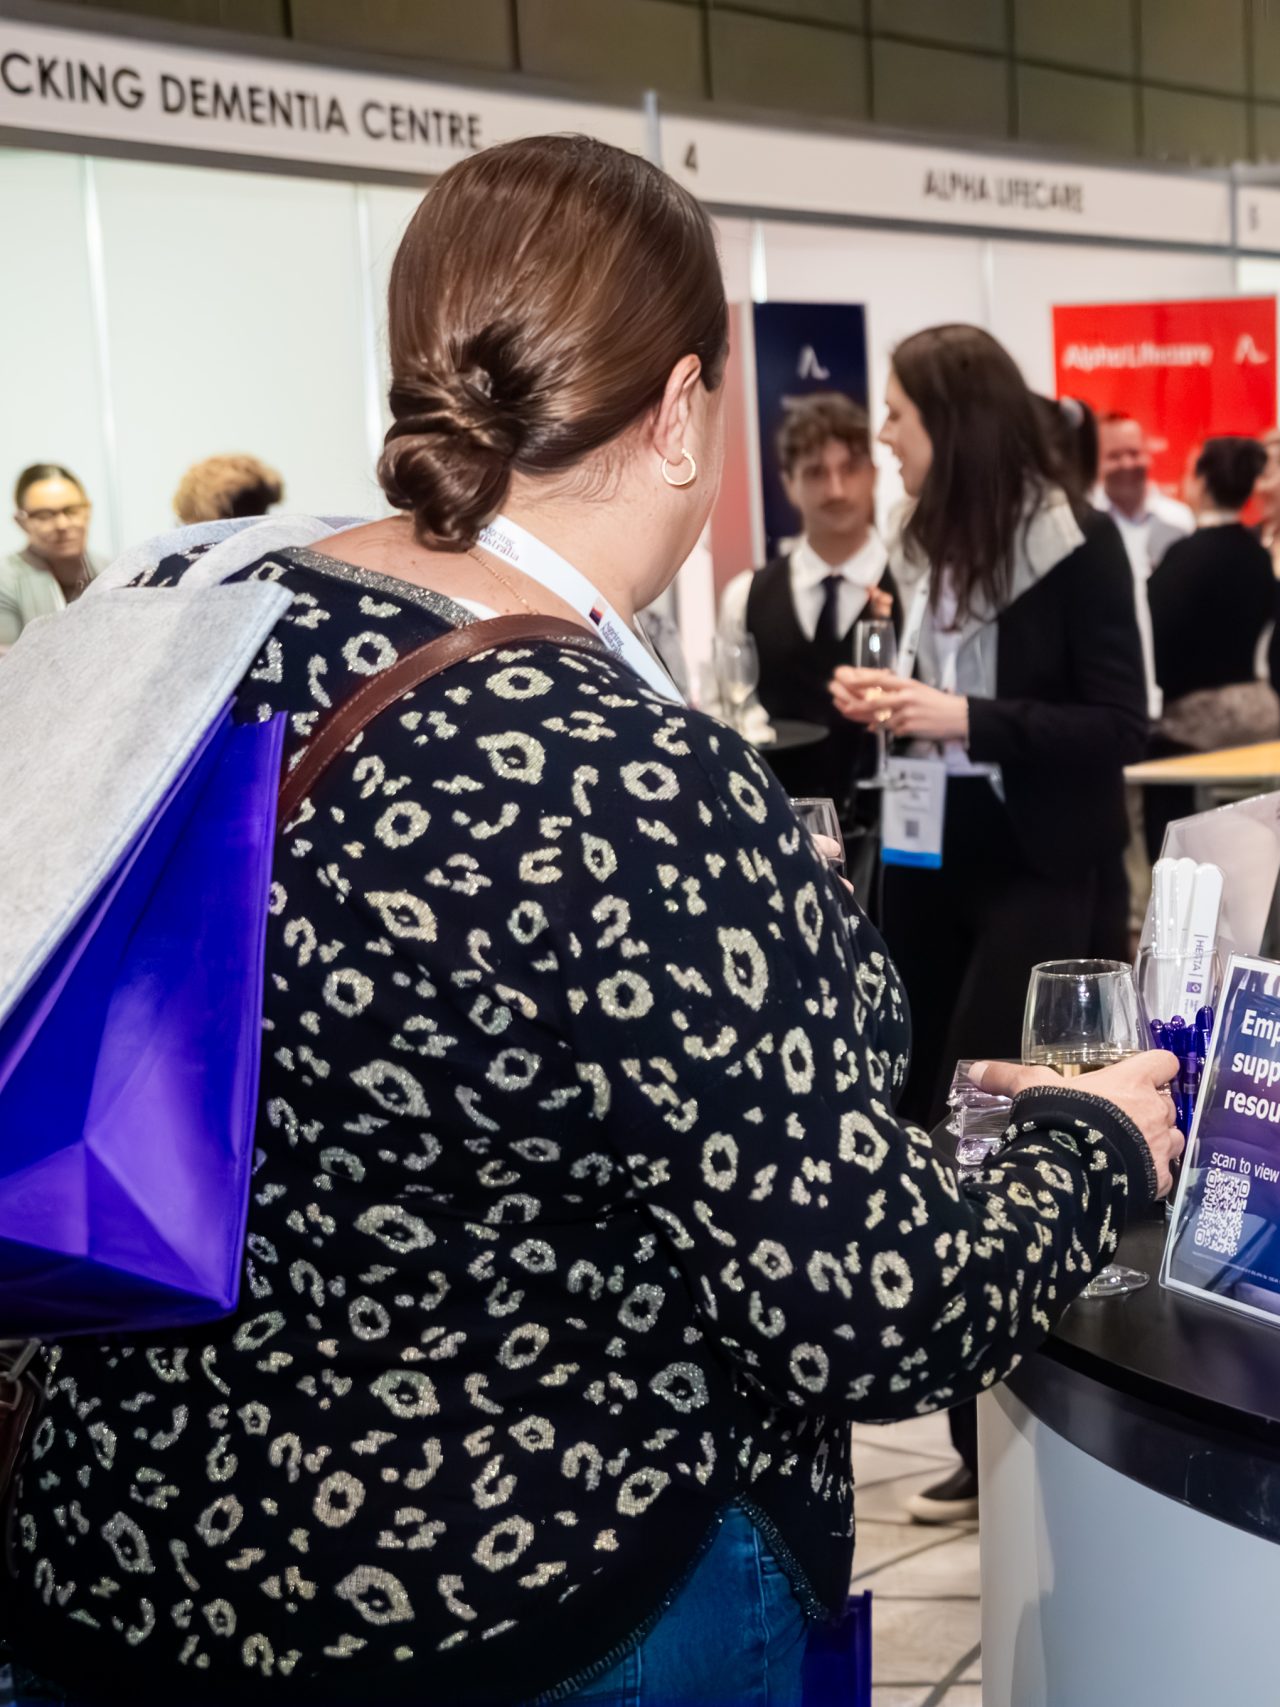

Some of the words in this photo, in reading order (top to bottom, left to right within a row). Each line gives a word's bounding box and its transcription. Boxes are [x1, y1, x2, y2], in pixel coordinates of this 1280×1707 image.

[1, 52, 146, 110] CKING
[160, 74, 349, 135] DEMENTIA
[361, 100, 483, 150] CENTRE
[684, 141, 698, 176] 4
[923, 168, 991, 204] ALPHA
[995, 177, 1084, 215] LIFECARE
[479, 534, 519, 562] ustralia
[1210, 1152, 1237, 1171] scan
[1239, 1157, 1251, 1175] to
[1254, 1163, 1280, 1184] view
